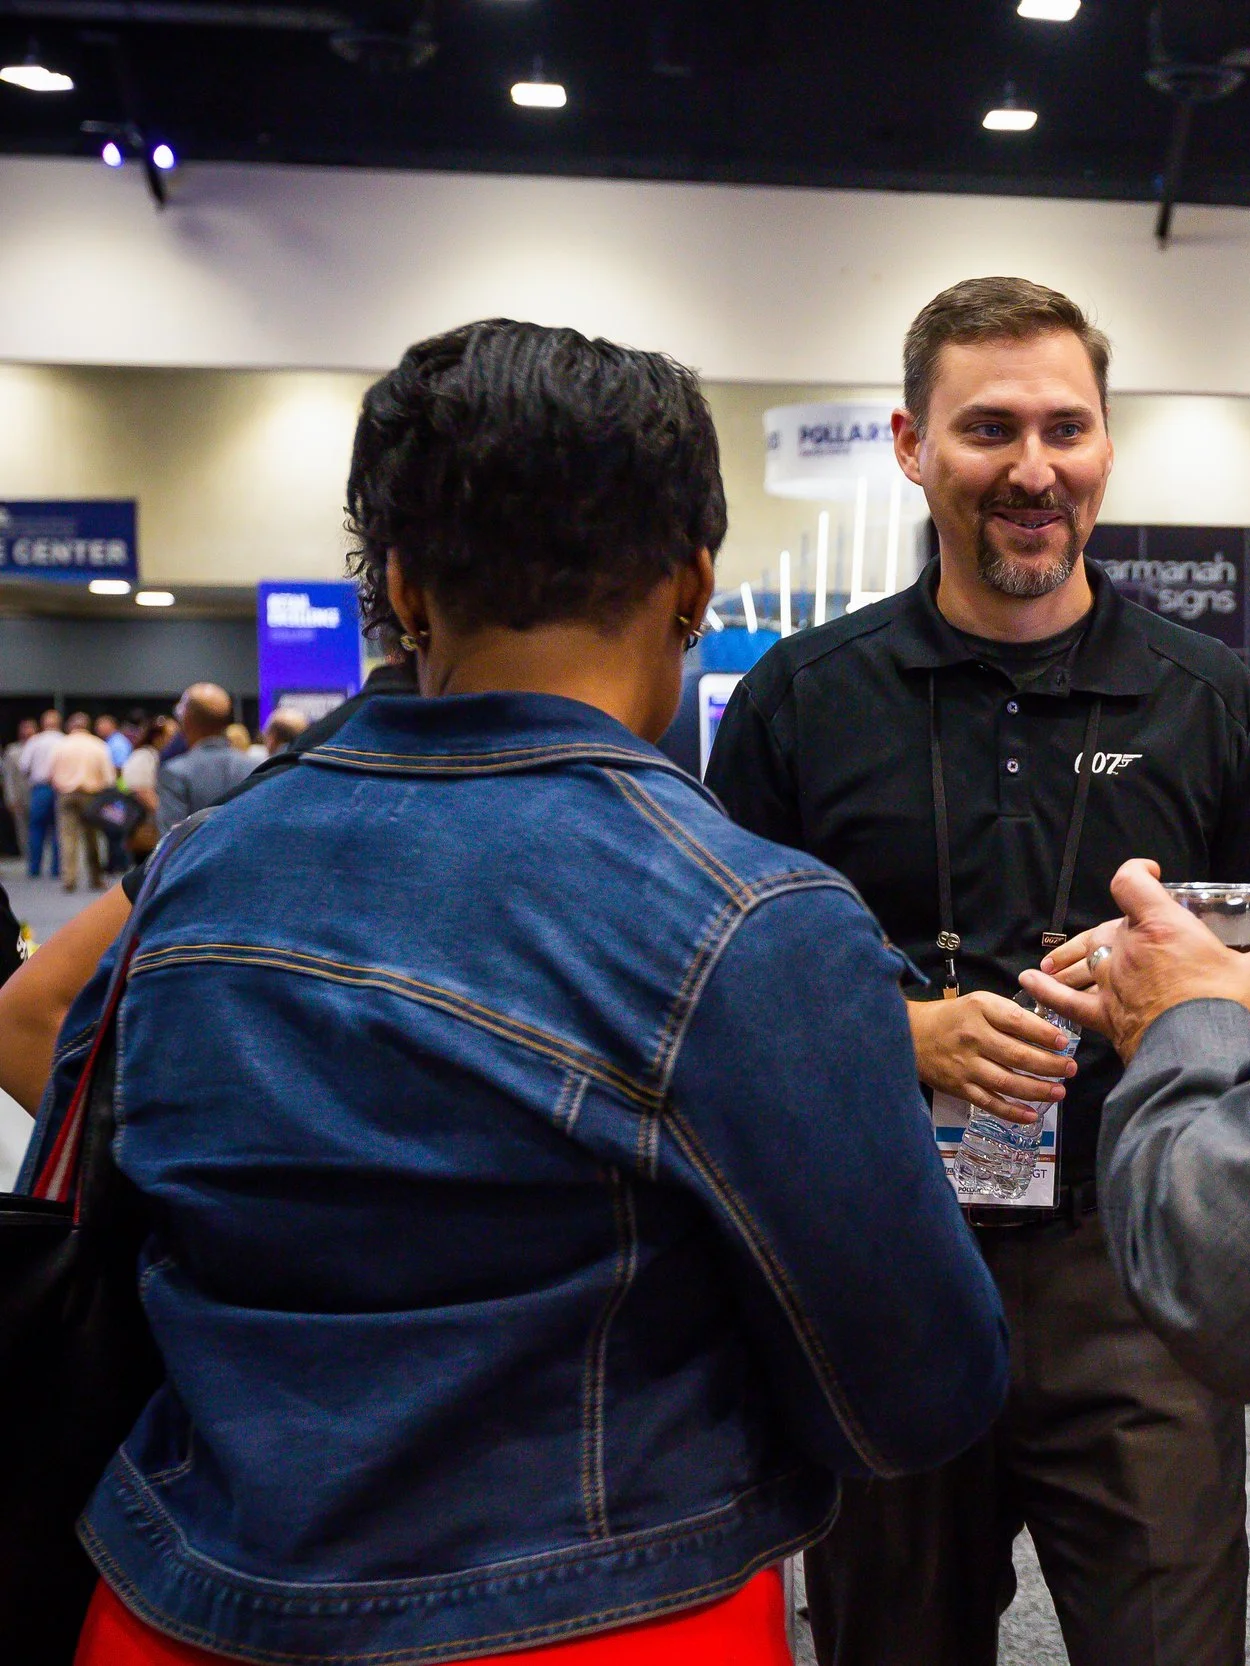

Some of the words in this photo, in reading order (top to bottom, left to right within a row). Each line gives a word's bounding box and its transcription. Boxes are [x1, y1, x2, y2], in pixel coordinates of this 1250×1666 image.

[12, 537, 128, 566] CENTER
[1097, 552, 1237, 585] armanah
[1158, 588, 1237, 620] signs
